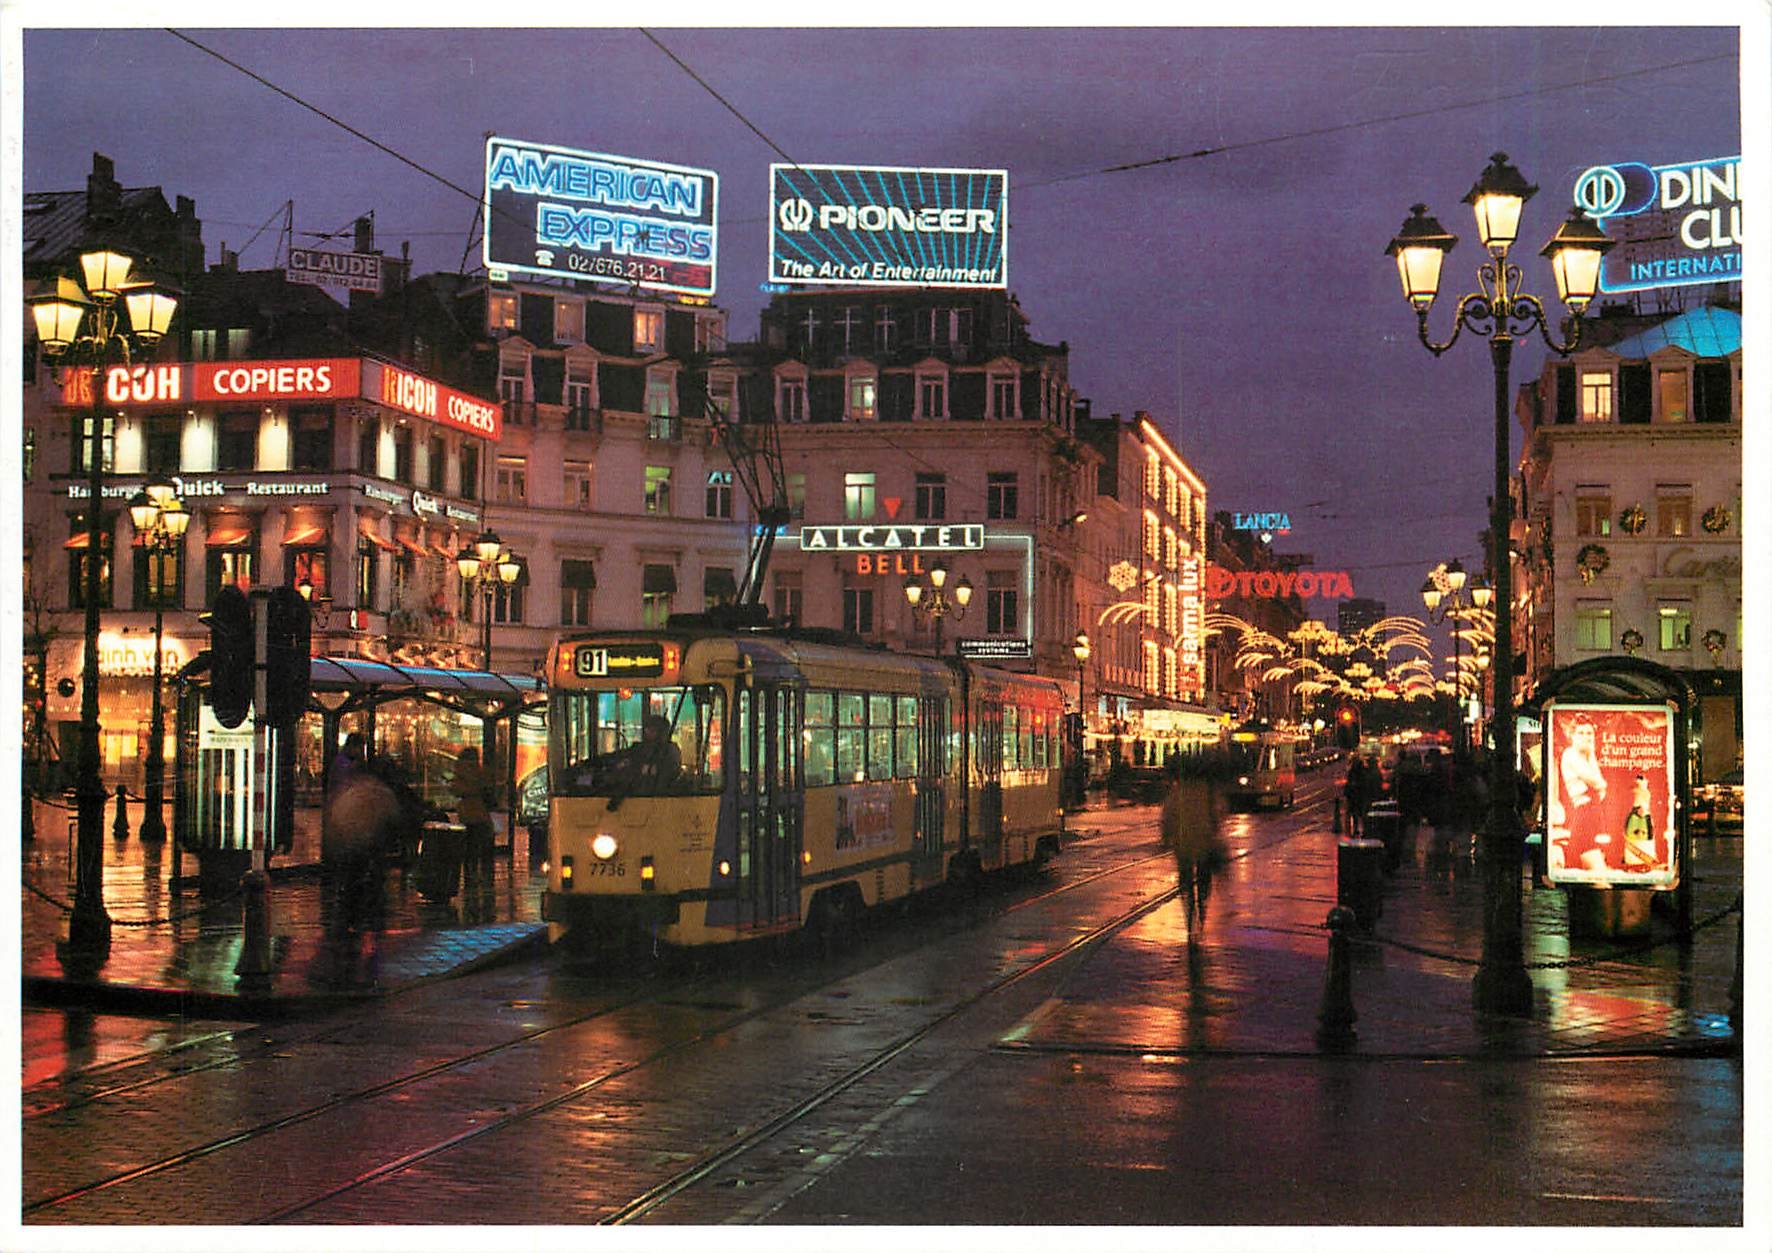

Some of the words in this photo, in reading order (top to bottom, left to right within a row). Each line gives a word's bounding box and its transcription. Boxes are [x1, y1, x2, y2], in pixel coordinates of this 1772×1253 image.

[489, 146, 704, 217] AMERICAN
[820, 205, 995, 233] PIONEER
[536, 202, 714, 266] EXPRESS
[291, 250, 378, 277] CLAUDE
[782, 259, 814, 278] The
[818, 260, 847, 279] Art
[850, 261, 867, 279] of
[872, 261, 996, 282] Entertainment
[213, 366, 332, 394] COPIERS
[384, 366, 438, 417] RICOH
[448, 395, 495, 433] COPIERS
[247, 482, 329, 496] Restaurant
[413, 490, 438, 516] Quick
[1234, 513, 1291, 530] LANCIA
[809, 527, 976, 548] ALCATEL
[857, 554, 925, 575] BELL
[1178, 559, 1198, 592] lux
[1236, 571, 1354, 598] TOYOTA
[581, 652, 604, 673] 91
[1602, 732, 1616, 743] La
[1619, 732, 1661, 744] couleur
[1601, 744, 1627, 755] d'un
[1630, 745, 1663, 759] grand
[590, 863, 625, 876] 7736
